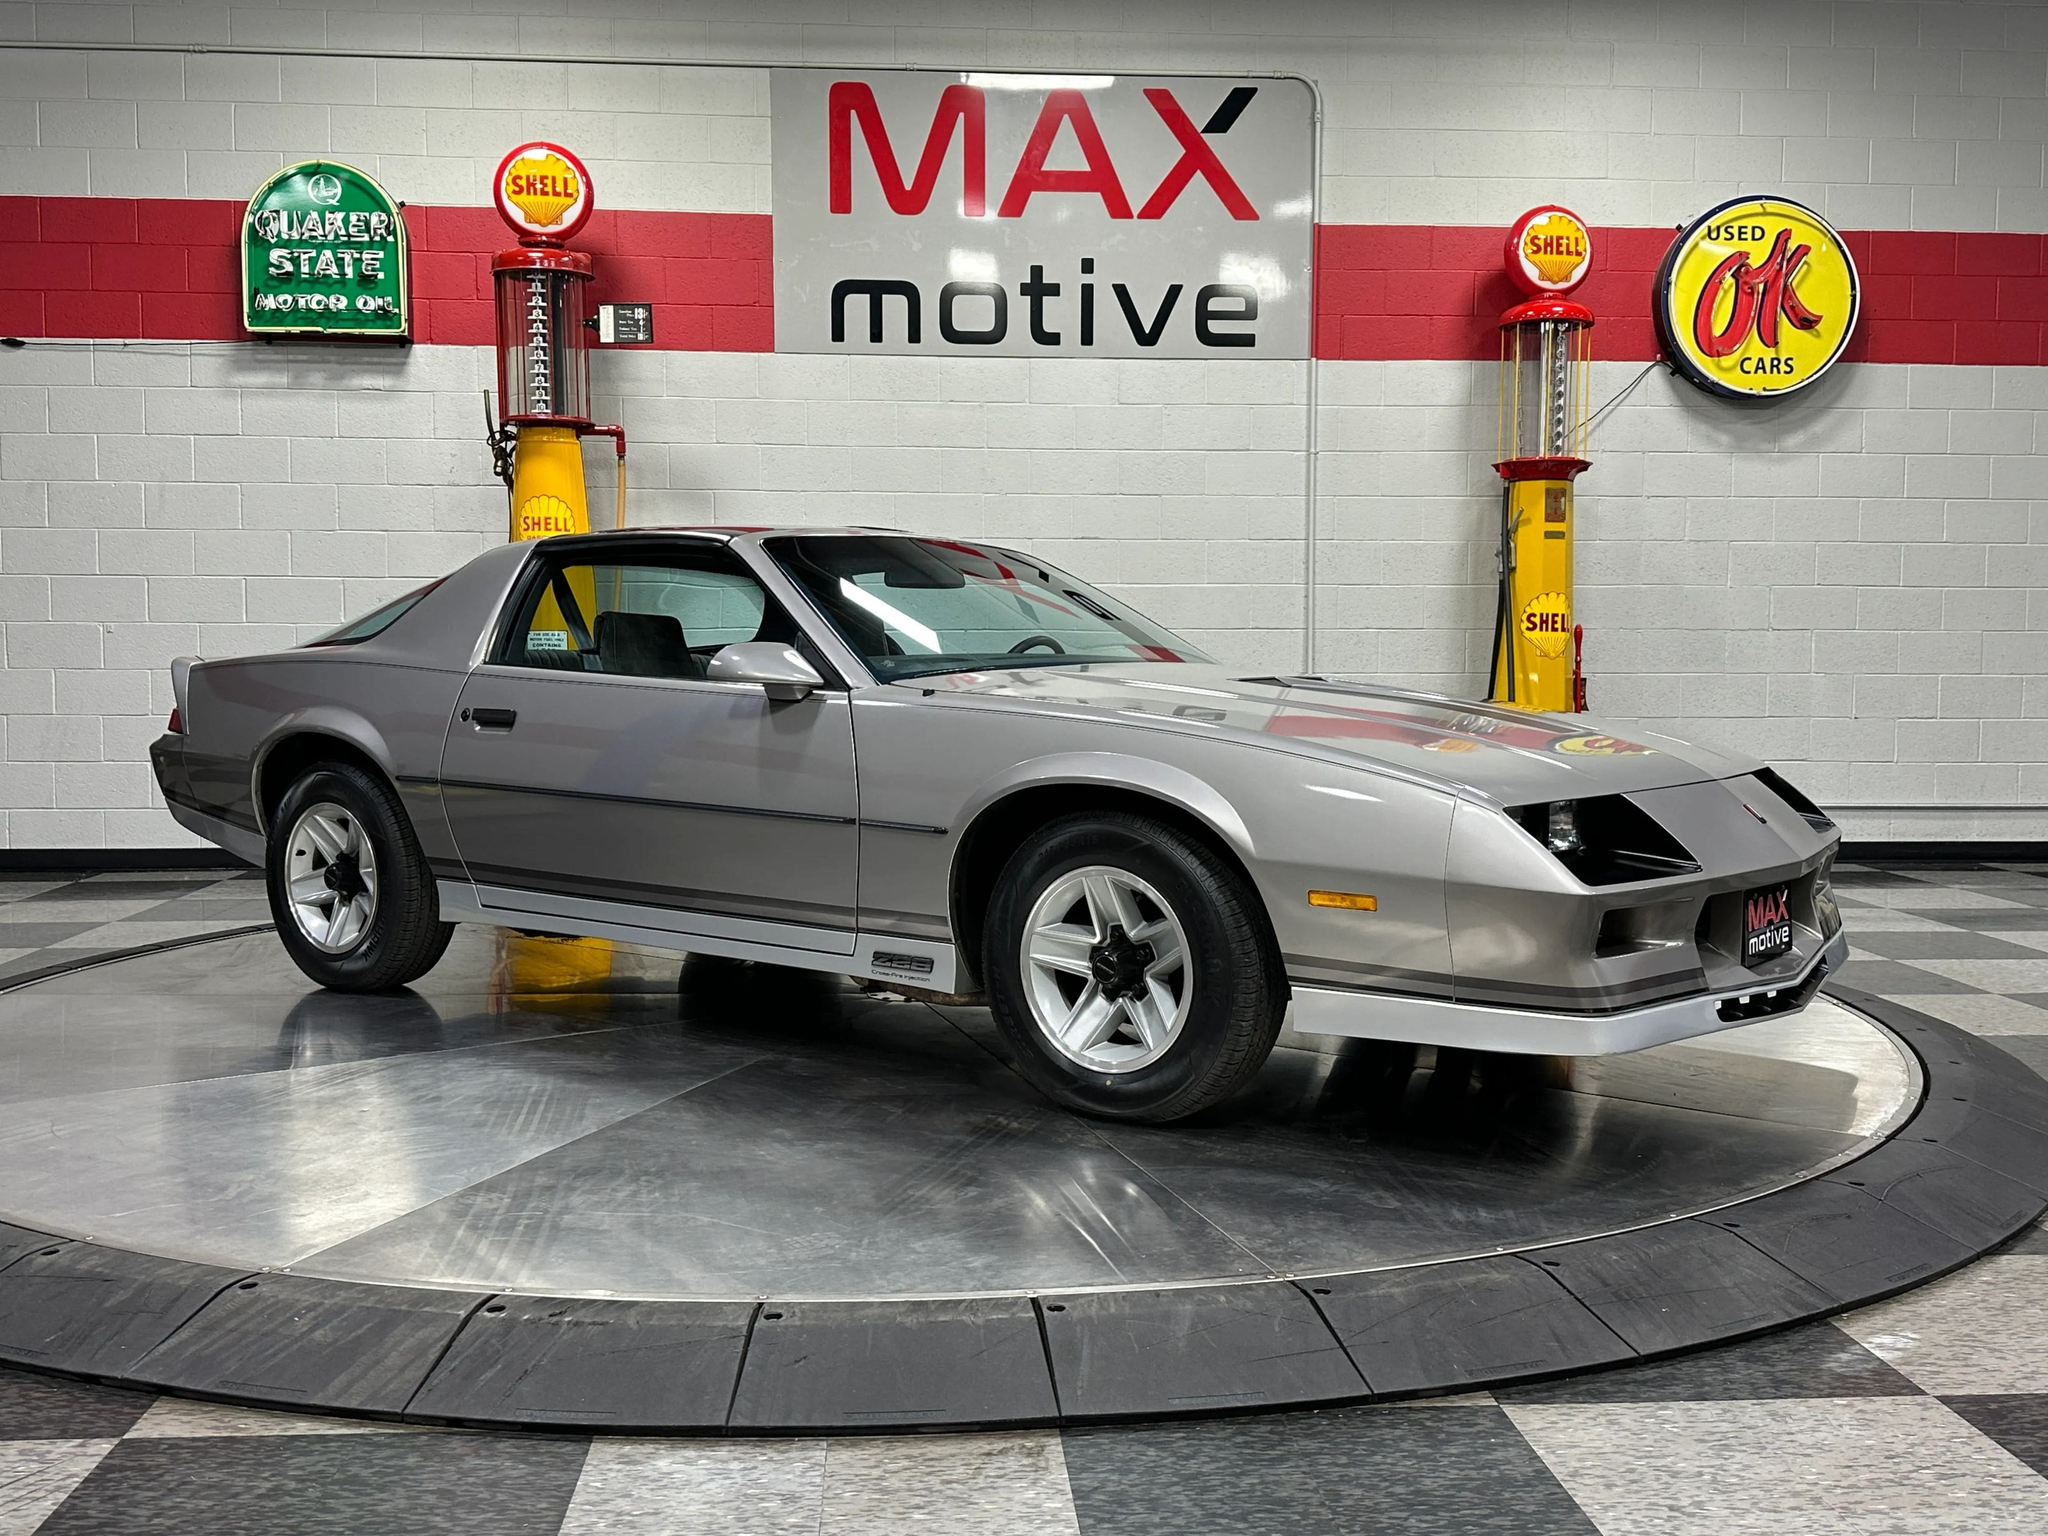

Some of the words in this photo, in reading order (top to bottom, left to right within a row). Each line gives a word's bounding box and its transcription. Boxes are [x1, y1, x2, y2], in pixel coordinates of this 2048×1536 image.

[829, 81, 1260, 221] MAX
[511, 174, 574, 198] SHELL
[254, 208, 396, 244] QUAKER
[1706, 225, 1766, 241] USED
[1529, 234, 1583, 257] SHELL
[268, 247, 386, 279] STATE
[254, 293, 348, 312] MOTOR
[355, 294, 401, 314] OIL
[831, 257, 1258, 347] motive
[1692, 227, 1823, 358] OK
[1739, 356, 1794, 375] CARS
[537, 404, 545, 412] 10
[523, 516, 570, 532] SHELL
[1748, 889, 1788, 932] MAX
[1748, 925, 1789, 955] motive
